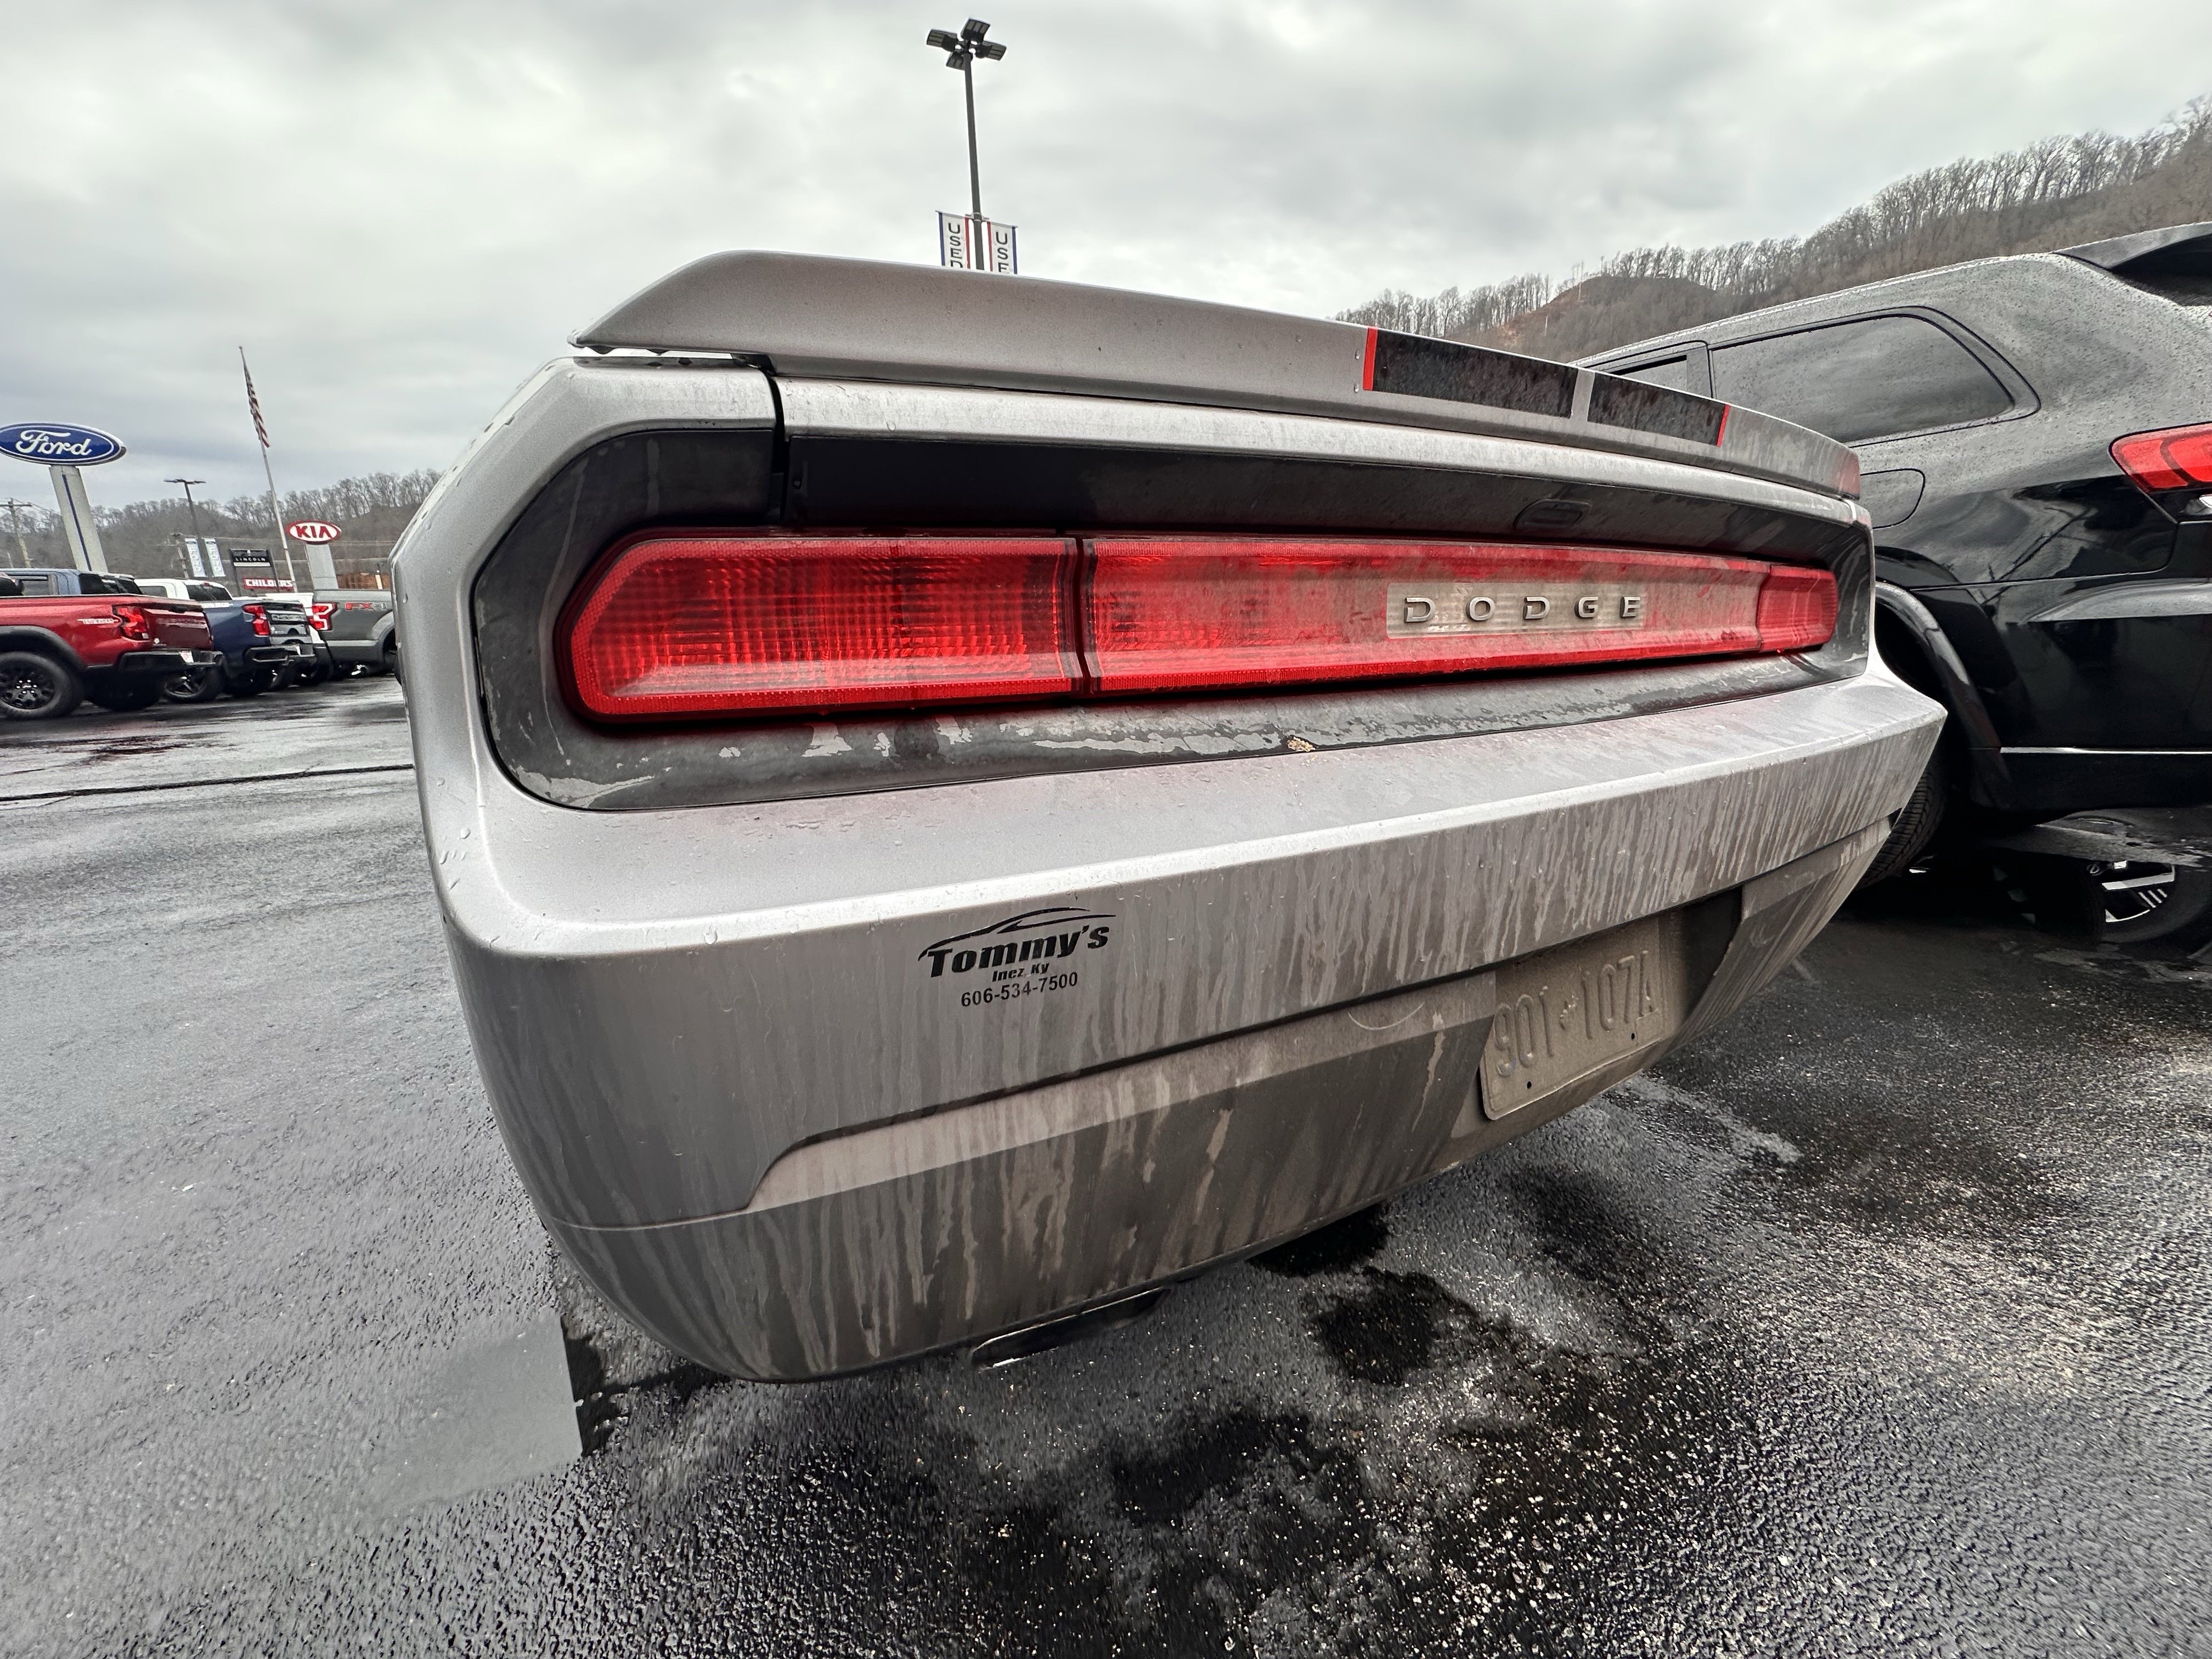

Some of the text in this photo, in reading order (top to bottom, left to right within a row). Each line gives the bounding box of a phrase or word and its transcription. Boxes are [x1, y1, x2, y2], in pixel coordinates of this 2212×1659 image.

[15, 430, 92, 455] Ford
[296, 526, 332, 538] KIA
[1404, 596, 1641, 623] DODGE
[927, 925, 1110, 978] Tommy's
[1031, 962, 1049, 974] Ky
[961, 972, 1078, 1007] 606-534-7500
